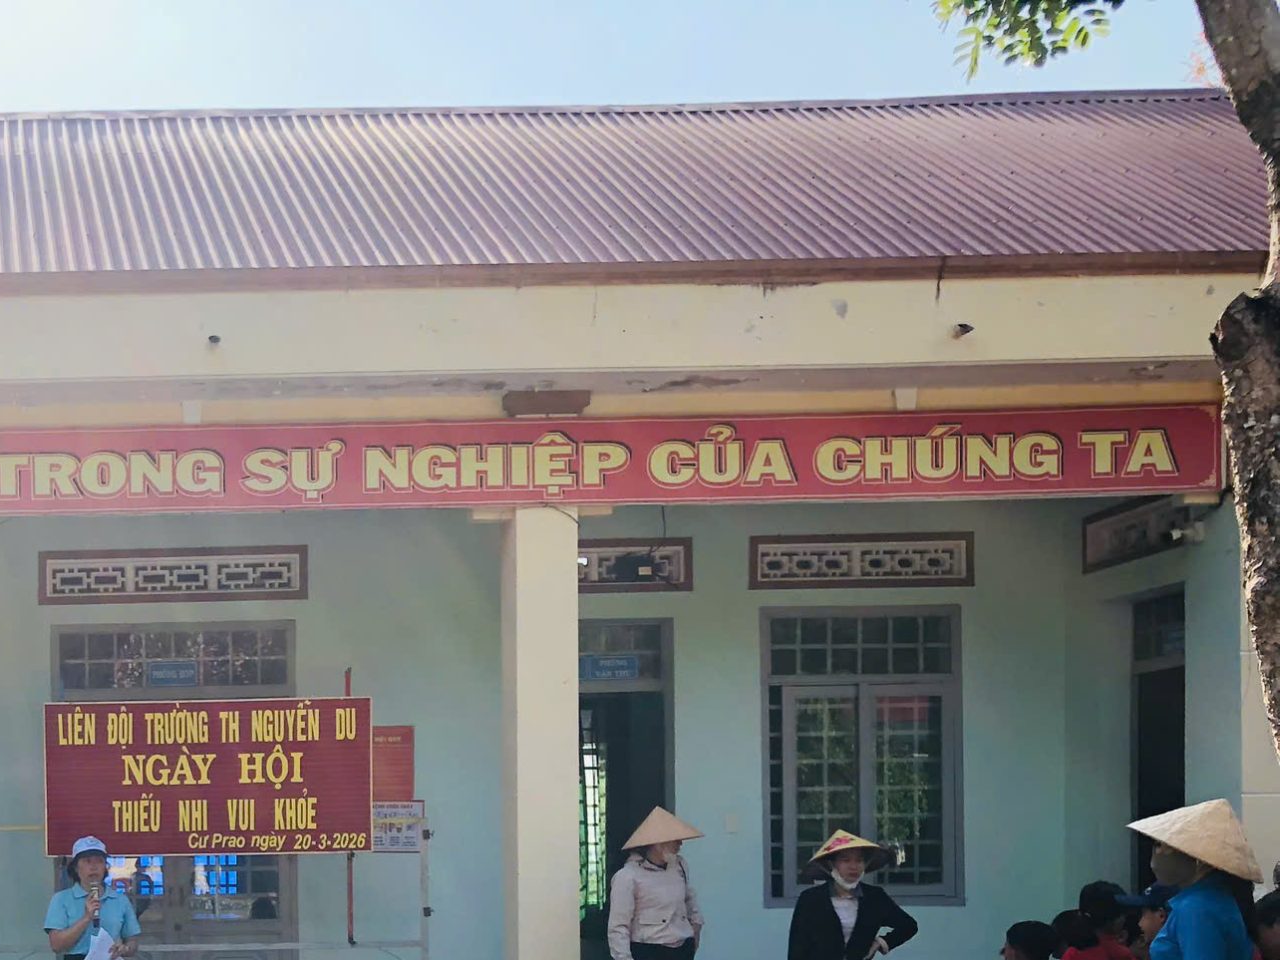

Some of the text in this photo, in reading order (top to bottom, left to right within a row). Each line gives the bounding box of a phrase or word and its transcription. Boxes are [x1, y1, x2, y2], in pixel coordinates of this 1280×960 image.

[241, 440, 344, 501] SỰ
[365, 433, 628, 496] NGHIỆP
[649, 426, 793, 486] CỦA
[815, 425, 1062, 482] CHÚNG
[1081, 430, 1175, 476] TA
[57, 700, 357, 750] LIÊN ĐỘI TRƯỜNG TH NGUYỄN DU
[121, 744, 304, 790] NGÀY HỘI
[112, 793, 161, 833] THIẾU
[178, 799, 209, 832] NHI
[226, 799, 255, 831] VUI
[188, 832, 209, 849] Cư
[211, 833, 246, 849] Prao
[251, 831, 287, 851] ngày
[293, 832, 367, 850] 20-3-2026
